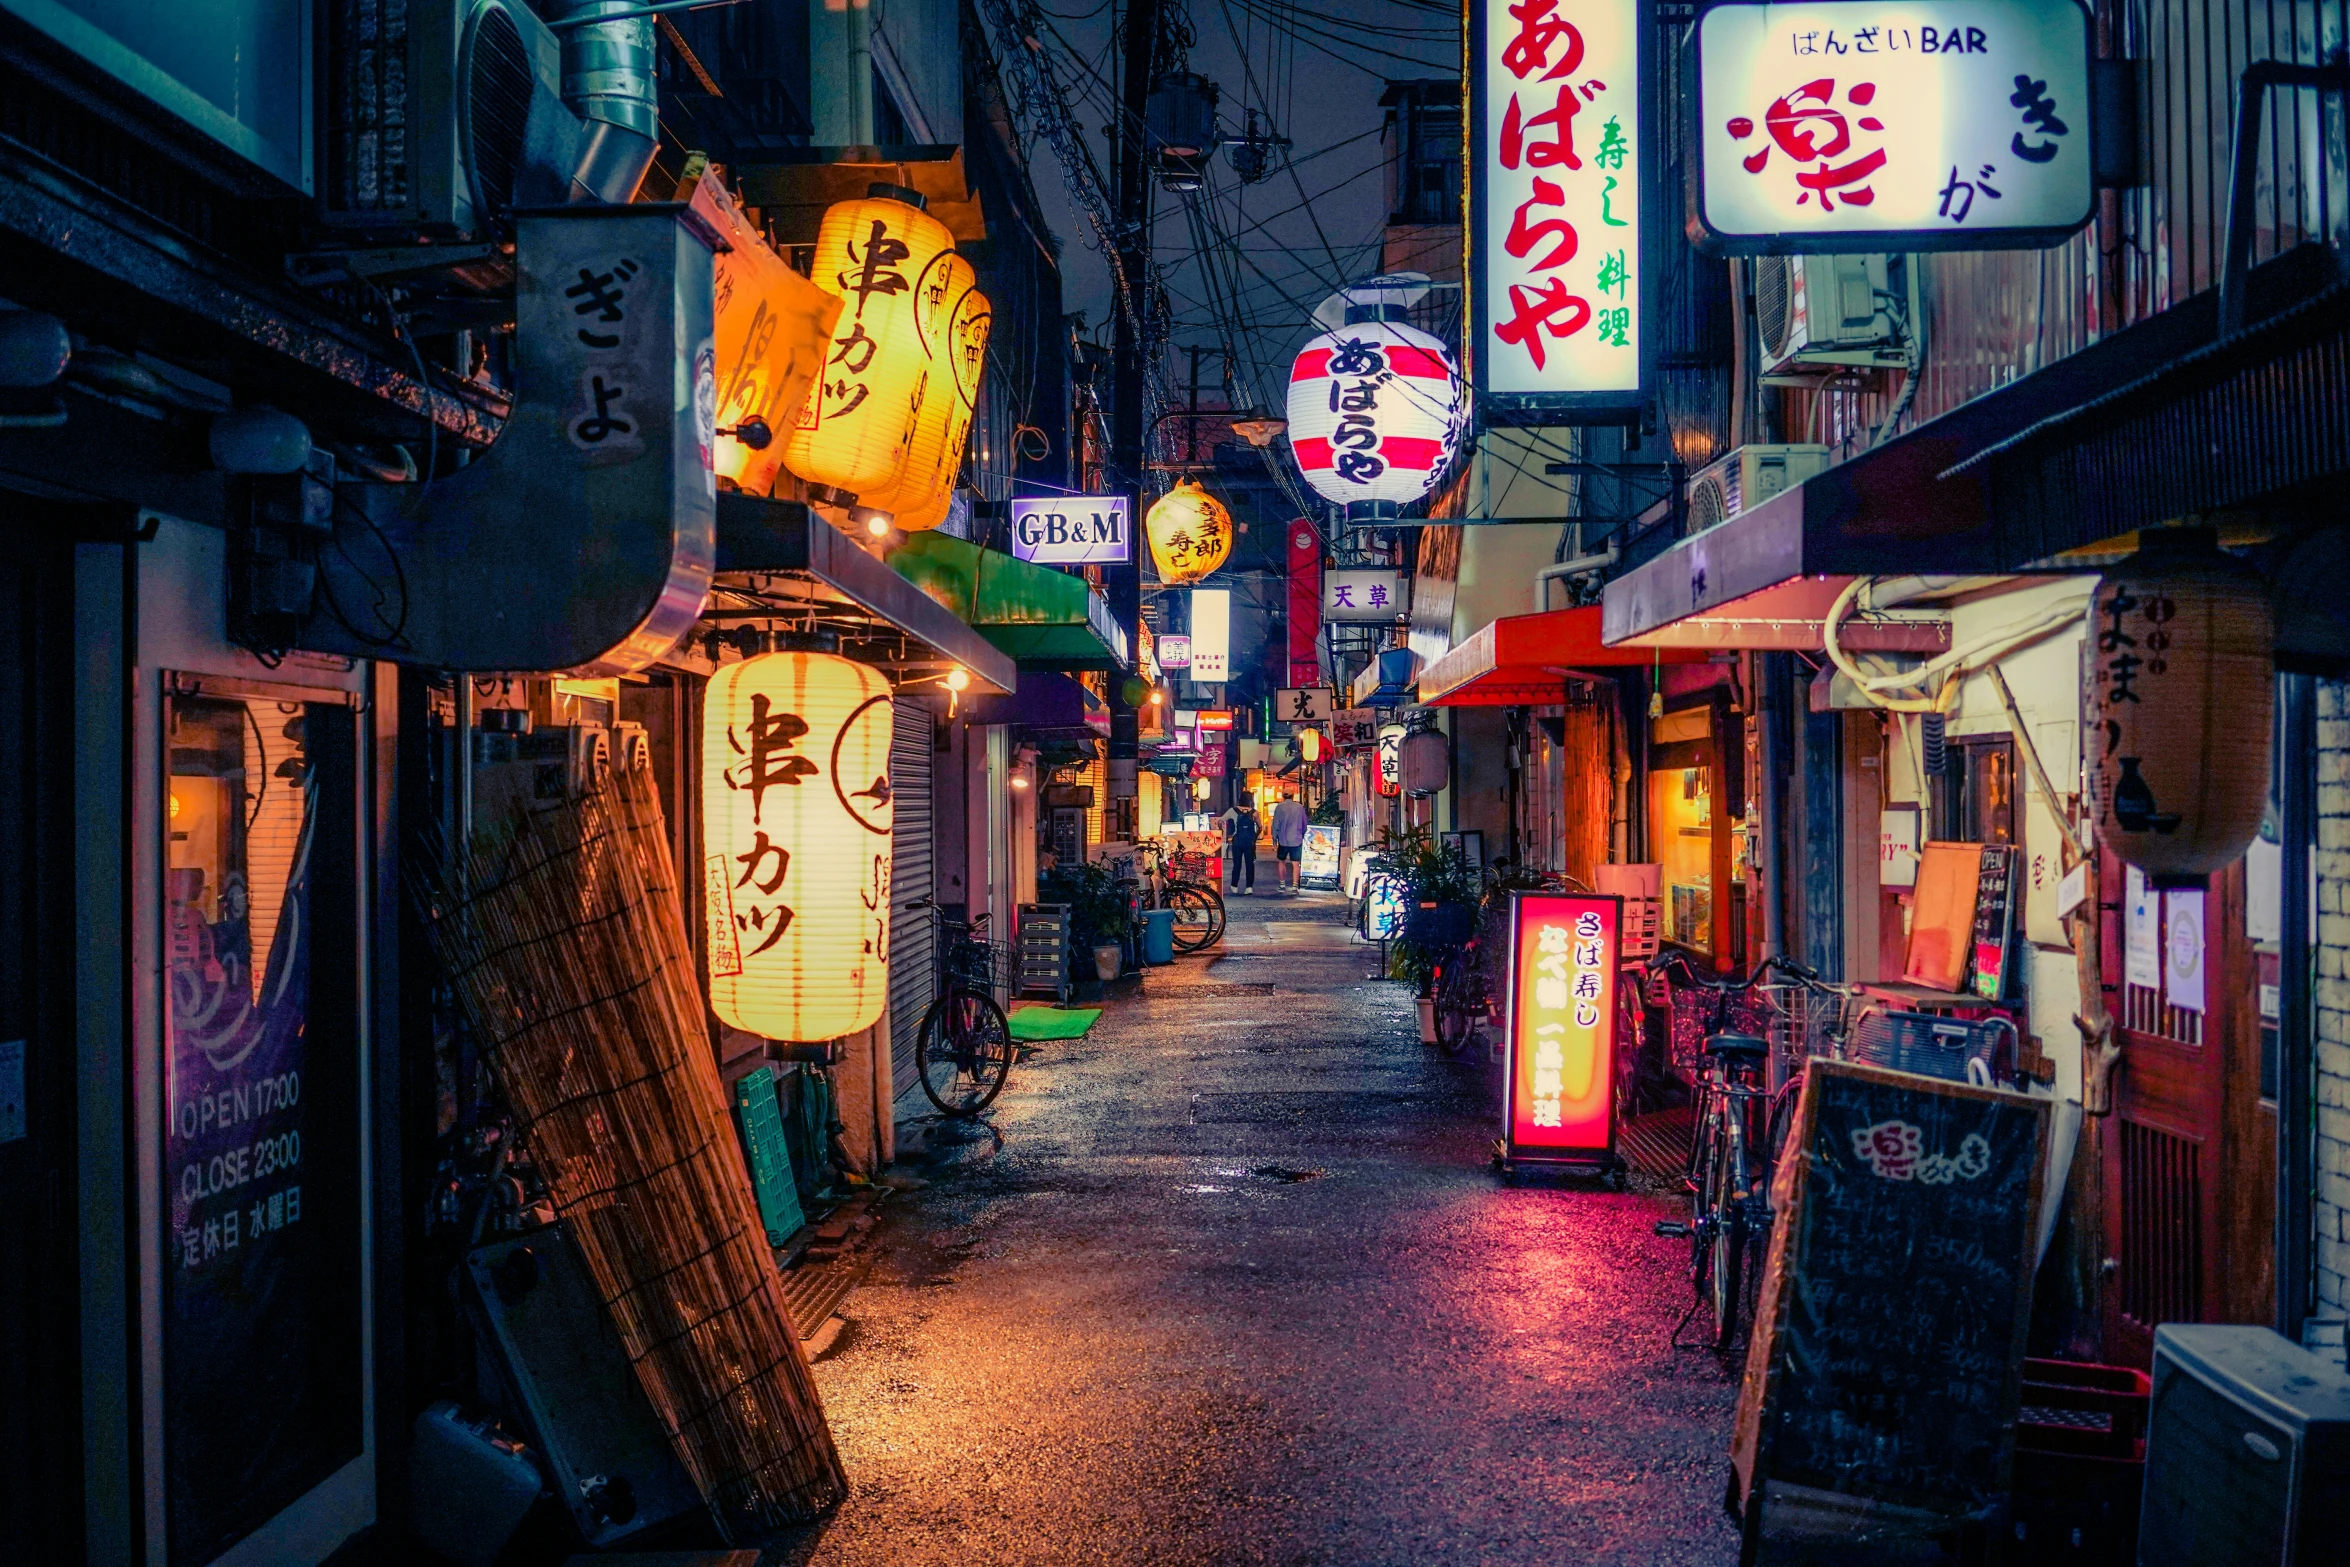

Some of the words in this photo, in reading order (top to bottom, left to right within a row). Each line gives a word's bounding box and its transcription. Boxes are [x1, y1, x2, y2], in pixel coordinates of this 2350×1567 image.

[1494, 0, 1606, 372] あばらや
[1594, 115, 1630, 227] 寿し
[823, 219, 911, 421] 串カツ
[1597, 249, 1631, 347] 料理
[1330, 337, 1392, 484] あばらや
[1018, 512, 1123, 546] GB&M
[1332, 584, 1389, 609] 天草
[1293, 691, 1315, 718] 光
[1380, 734, 1399, 777] 天草
[723, 693, 819, 959] 串カツ
[1576, 912, 1602, 1027] さば寿し
[182, 1085, 249, 1139] OPEN
[255, 1071, 299, 1115] 17:00
[182, 1147, 250, 1204] CLOSE
[254, 1130, 300, 1179] 23:00
[182, 1210, 239, 1268] 定休日
[250, 1186, 300, 1239] 水曜日
